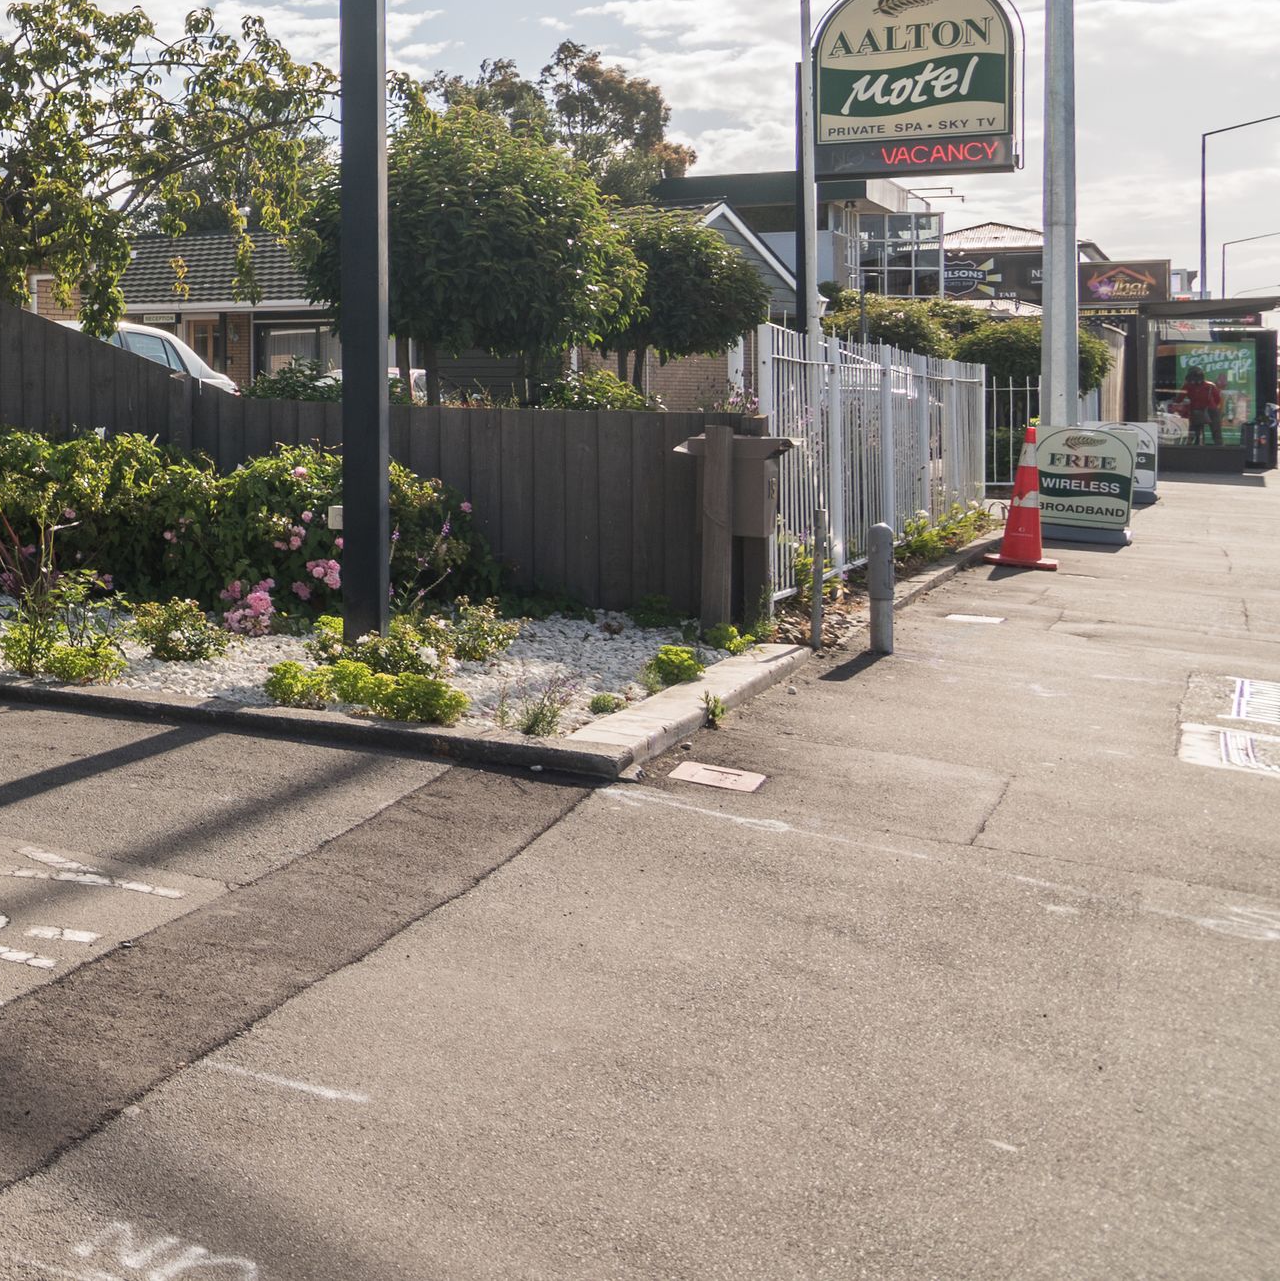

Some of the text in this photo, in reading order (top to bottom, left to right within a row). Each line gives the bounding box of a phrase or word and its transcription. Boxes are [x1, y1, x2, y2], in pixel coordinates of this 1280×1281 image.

[827, 15, 993, 59] AALTON
[840, 55, 979, 115] Motel
[828, 117, 996, 137] PRIVATE SPA SKY TV
[881, 141, 999, 165] VACANCY
[944, 269, 984, 279] ILSONS
[1048, 452, 1117, 470] FREE
[1041, 477, 1120, 494] WIRELESS
[1039, 501, 1125, 518] BROADBAND
